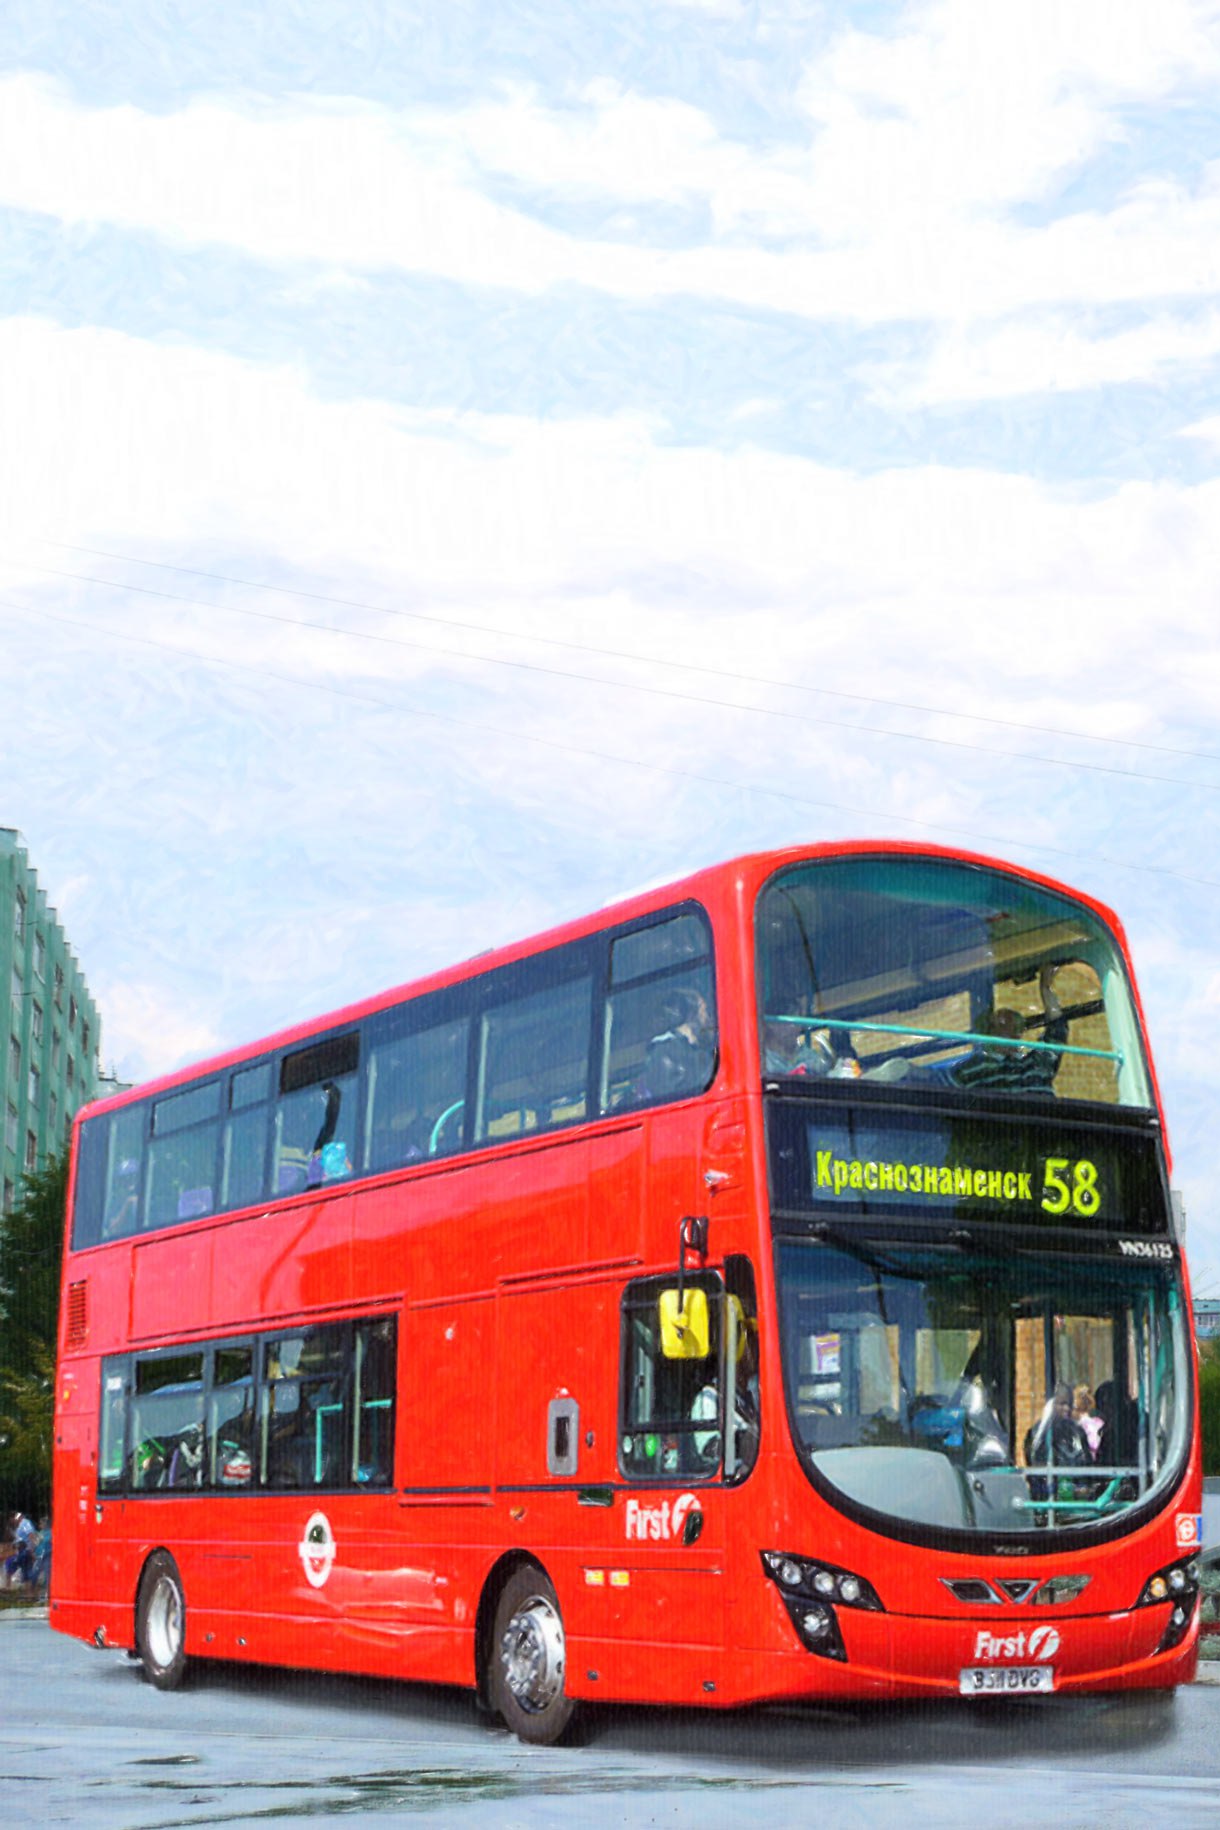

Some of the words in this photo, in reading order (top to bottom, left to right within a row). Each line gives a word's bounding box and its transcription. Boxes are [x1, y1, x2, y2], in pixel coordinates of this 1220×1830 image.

[816, 1150, 1032, 1200] Краснознаменск
[1041, 1158, 1100, 1217] 58
[626, 1499, 670, 1541] First
[975, 1631, 1026, 1658] First
